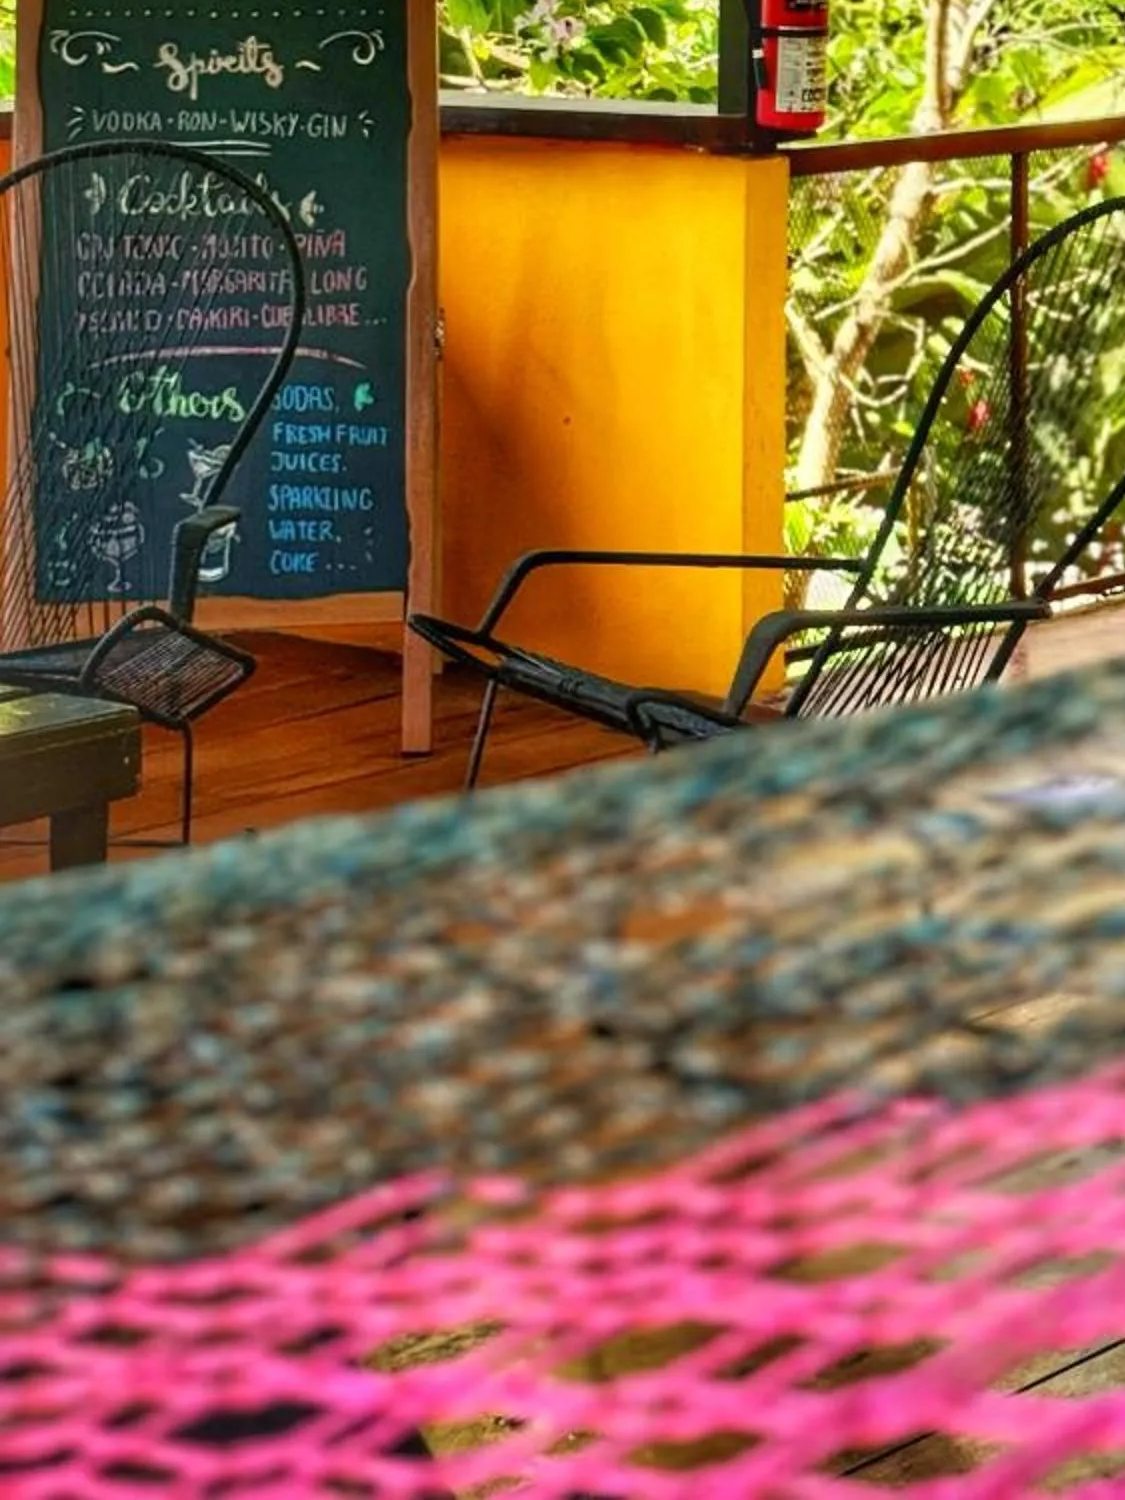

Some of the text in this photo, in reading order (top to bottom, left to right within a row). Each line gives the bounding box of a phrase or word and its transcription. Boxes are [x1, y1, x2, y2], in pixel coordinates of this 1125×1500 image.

[153, 36, 284, 100] Spirits
[93, 109, 162, 133] VODKA
[307, 113, 347, 138] GIN
[311, 267, 367, 294] LONG
[272, 422, 388, 446] FRESH FRUIT
